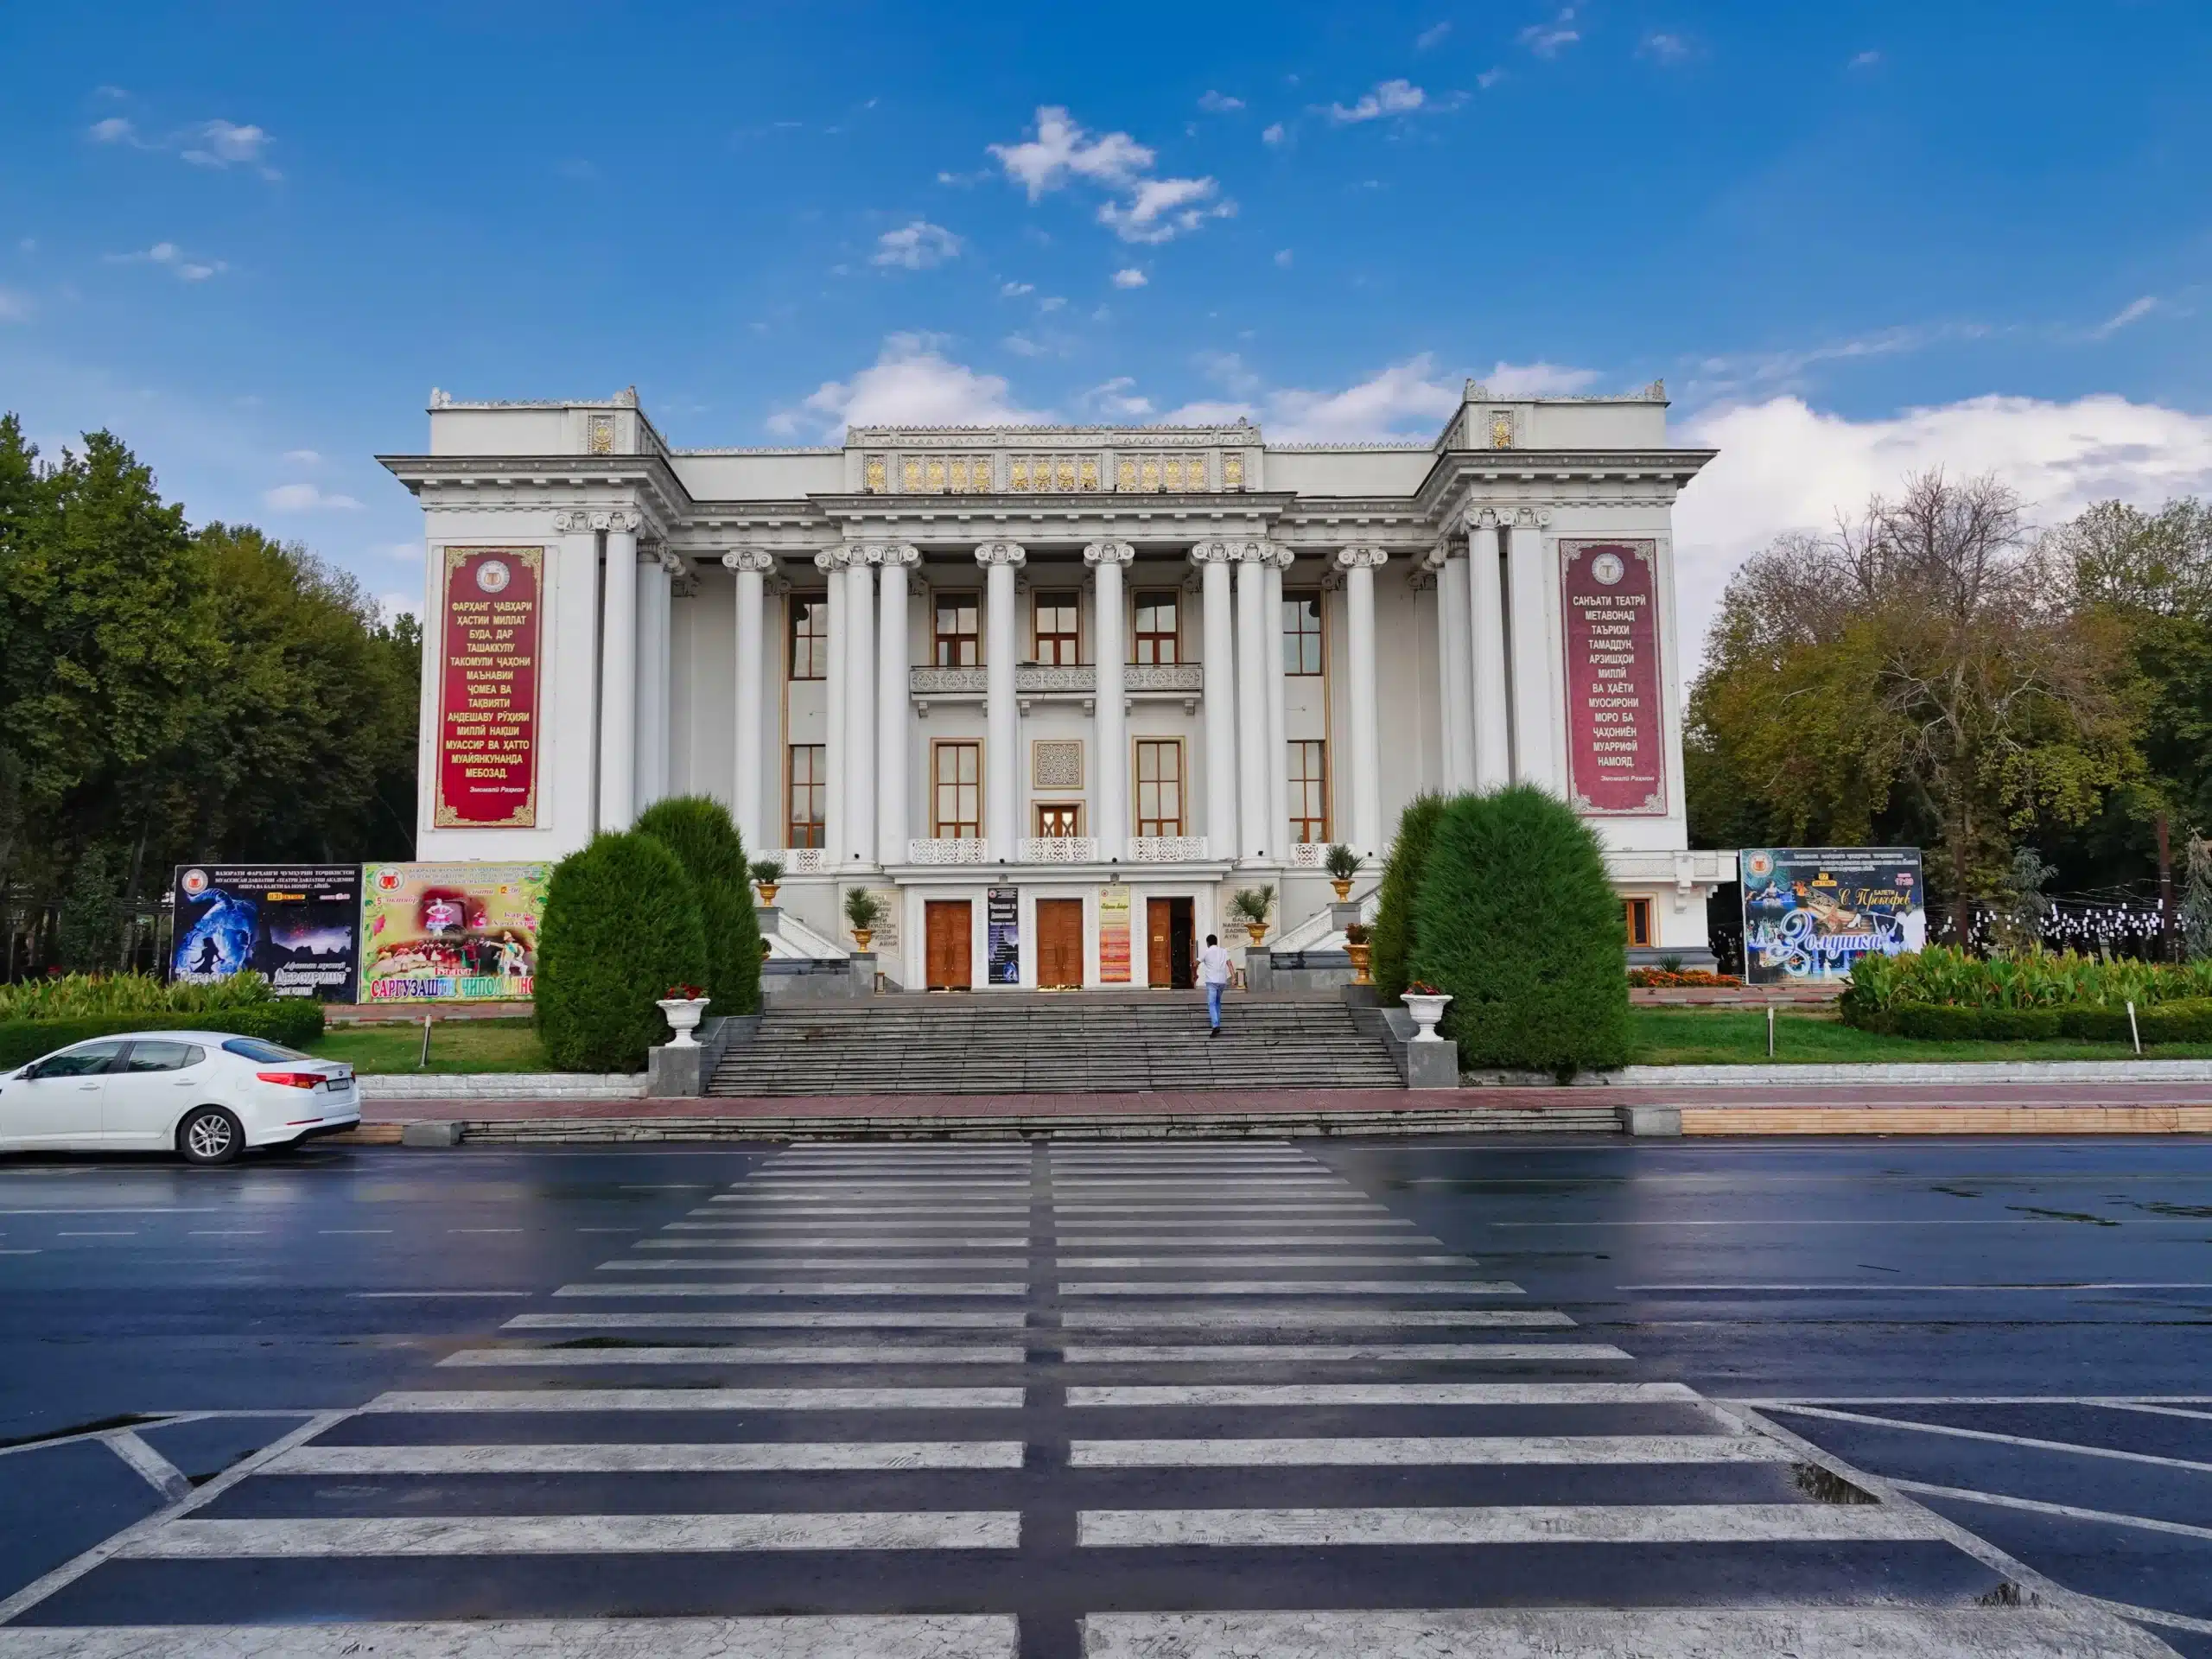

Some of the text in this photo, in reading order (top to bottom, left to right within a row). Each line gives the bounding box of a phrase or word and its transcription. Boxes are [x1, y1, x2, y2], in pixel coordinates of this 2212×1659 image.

[1573, 596, 1611, 606] САНЪАТИ
[452, 601, 532, 613] ФАРҲАНГ ҶАВҲАРИ
[456, 615, 526, 627] ҲАСТИИ МИЛЛАТ
[1585, 610, 1635, 622] МЕТАВОНАД
[469, 629, 513, 639] БУДА, ДАР
[1592, 626, 1630, 635] ТАЪРИХИ
[467, 643, 515, 652] ТАШАККУЛУ
[1588, 639, 1634, 651] ТАМАДДУН,
[450, 657, 531, 668] ТАКОМУЛИ ҶАҲОНИ
[1590, 654, 1635, 665] АРЗИШҲОИ
[467, 671, 513, 680] МАЪНАВИИ
[467, 684, 512, 695] ҶОМЕА ВА
[1592, 682, 1634, 695] ВА ҲАЁТИ
[467, 698, 510, 709] ТАҚВИЯТИ
[1589, 698, 1639, 708] МУОСИРОНИ
[448, 712, 493, 722] АНДЕШАВУ
[1595, 713, 1634, 722] МОРО БА
[490, 726, 519, 737] НАҚШИ
[1593, 726, 1637, 739] ҶАҲОНИЁН
[446, 741, 530, 751] МУАССИР ВА ҲАТТО
[452, 753, 523, 765] МУАЙЯНКУНАНДА
[1598, 757, 1635, 767] НАМОЯД.
[465, 768, 507, 779] МЕБОЗАД.
[371, 977, 456, 998] САРГУЗАШТИ
